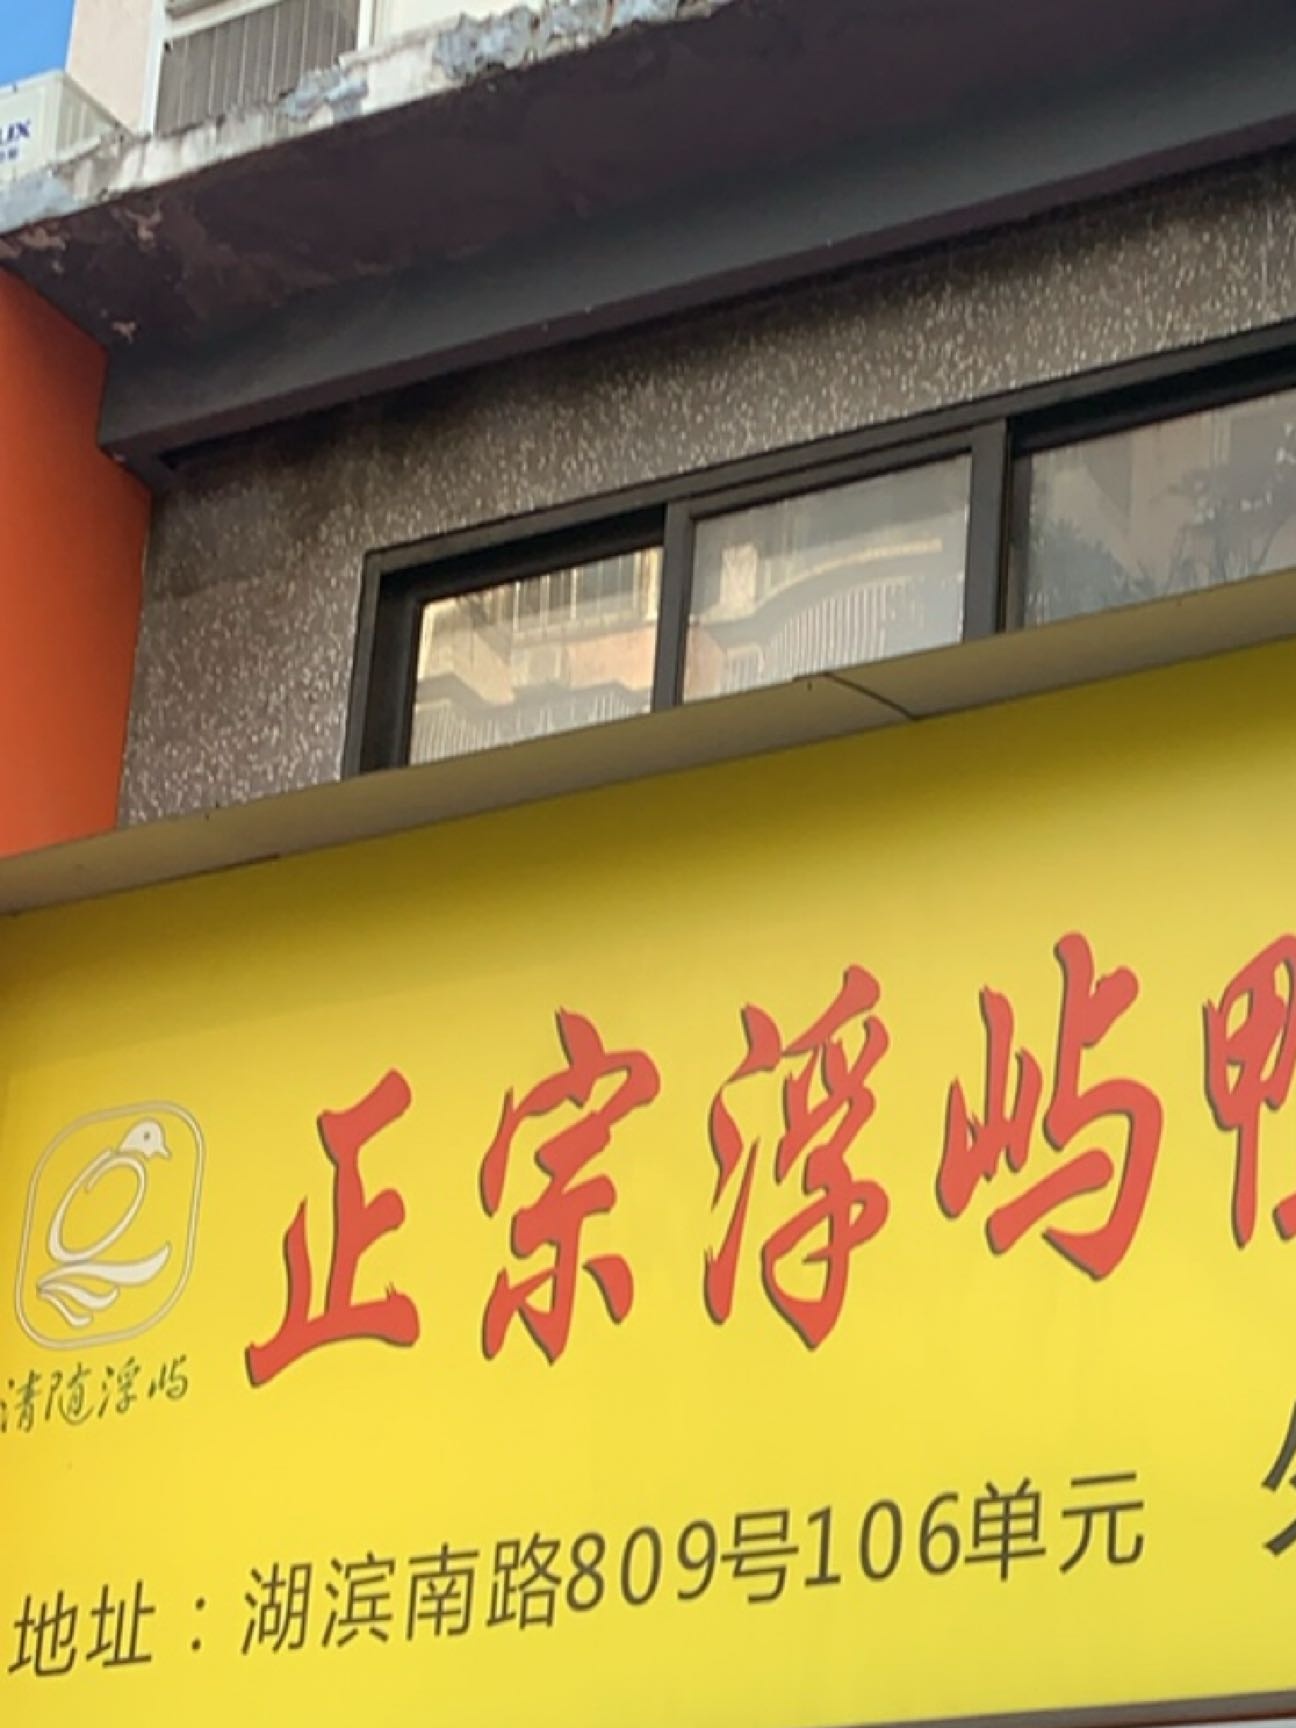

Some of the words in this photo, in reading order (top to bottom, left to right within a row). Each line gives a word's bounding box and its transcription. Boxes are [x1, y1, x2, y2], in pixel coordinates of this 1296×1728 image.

[7, 1470, 1146, 1679] 地址：湖滨南路809号106单元
